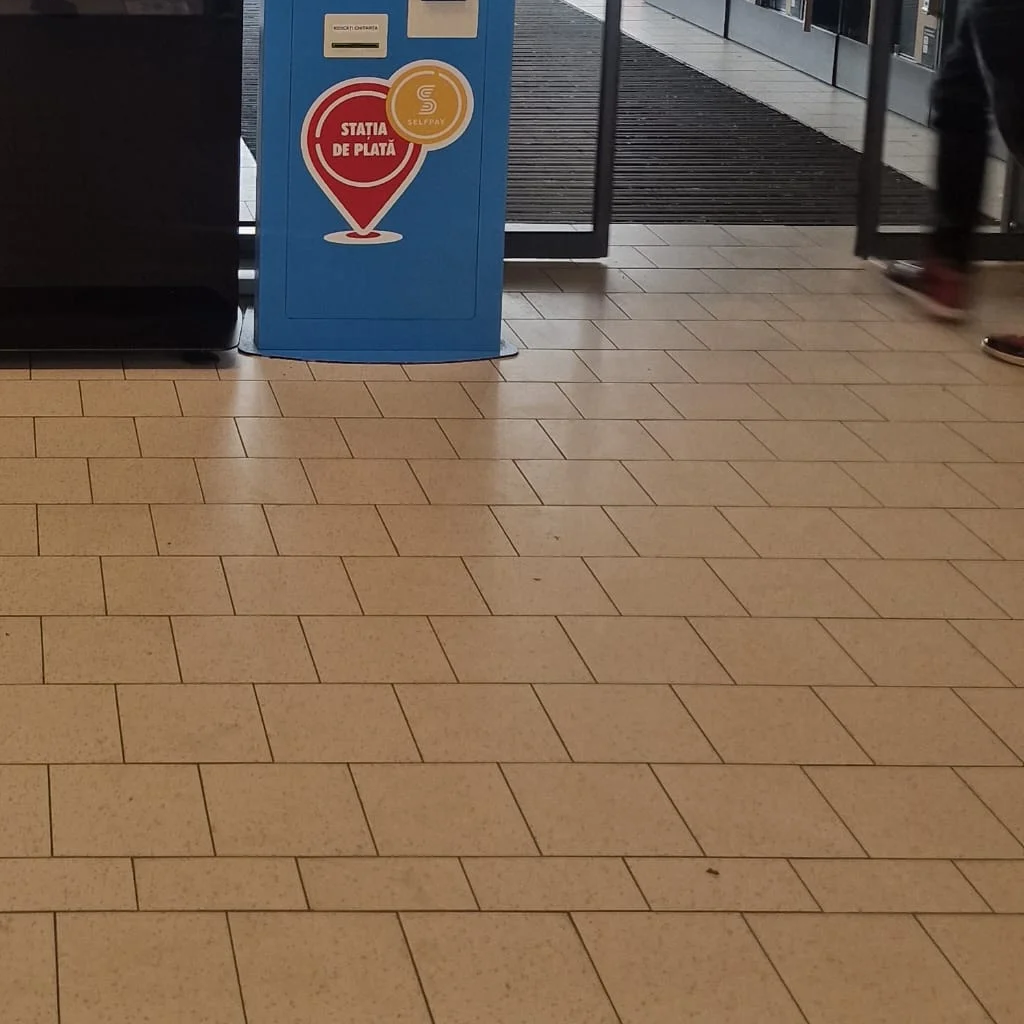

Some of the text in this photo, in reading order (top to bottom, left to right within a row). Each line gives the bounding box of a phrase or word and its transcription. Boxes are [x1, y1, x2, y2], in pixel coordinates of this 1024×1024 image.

[341, 122, 388, 140] STAȚIA
[407, 118, 444, 126] SELFPAY
[332, 139, 396, 157] DE PLATĂ
